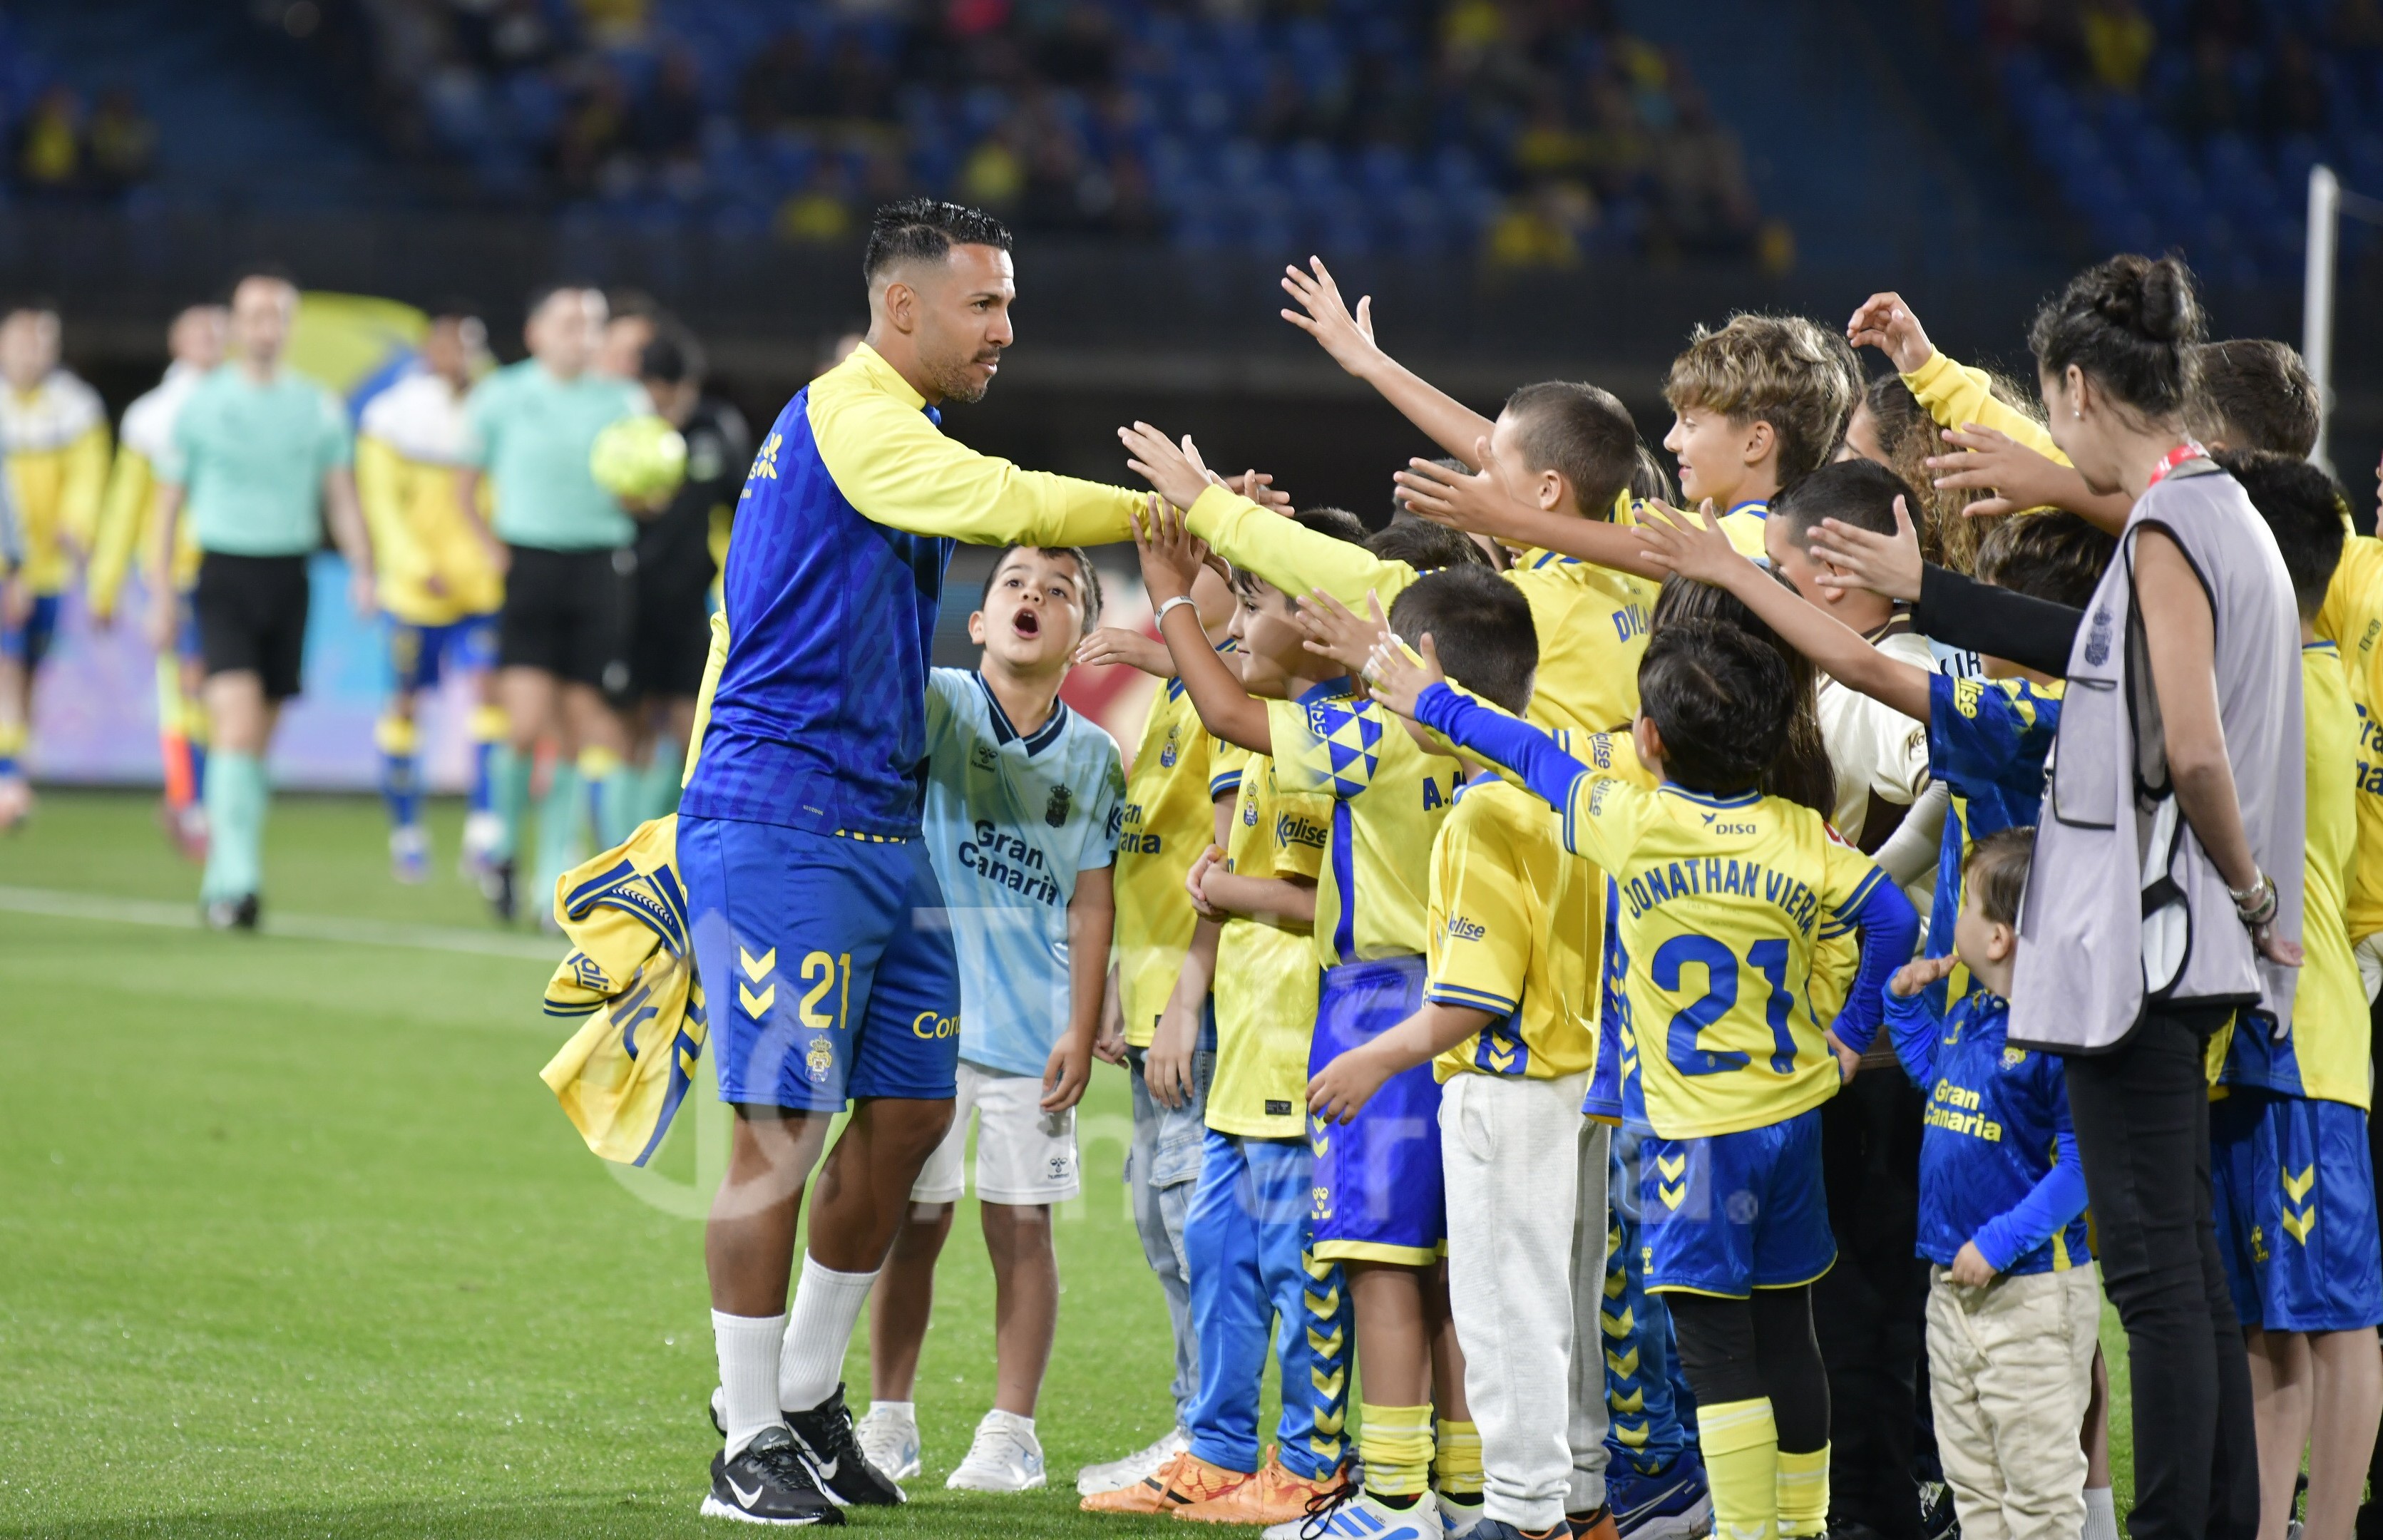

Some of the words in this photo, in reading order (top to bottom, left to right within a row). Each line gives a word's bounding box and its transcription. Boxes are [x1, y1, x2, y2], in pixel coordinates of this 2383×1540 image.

[975, 820, 1043, 871] Gran
[1120, 828, 1161, 854] aria
[1275, 811, 1328, 849] Kalise
[958, 841, 1060, 905] Canaria
[1624, 857, 1761, 920] JONATHAN
[799, 951, 851, 1029] 21
[1651, 934, 1798, 1077] 21
[1934, 1077, 1980, 1111] Gran
[1925, 1102, 2002, 1142] Canaria
